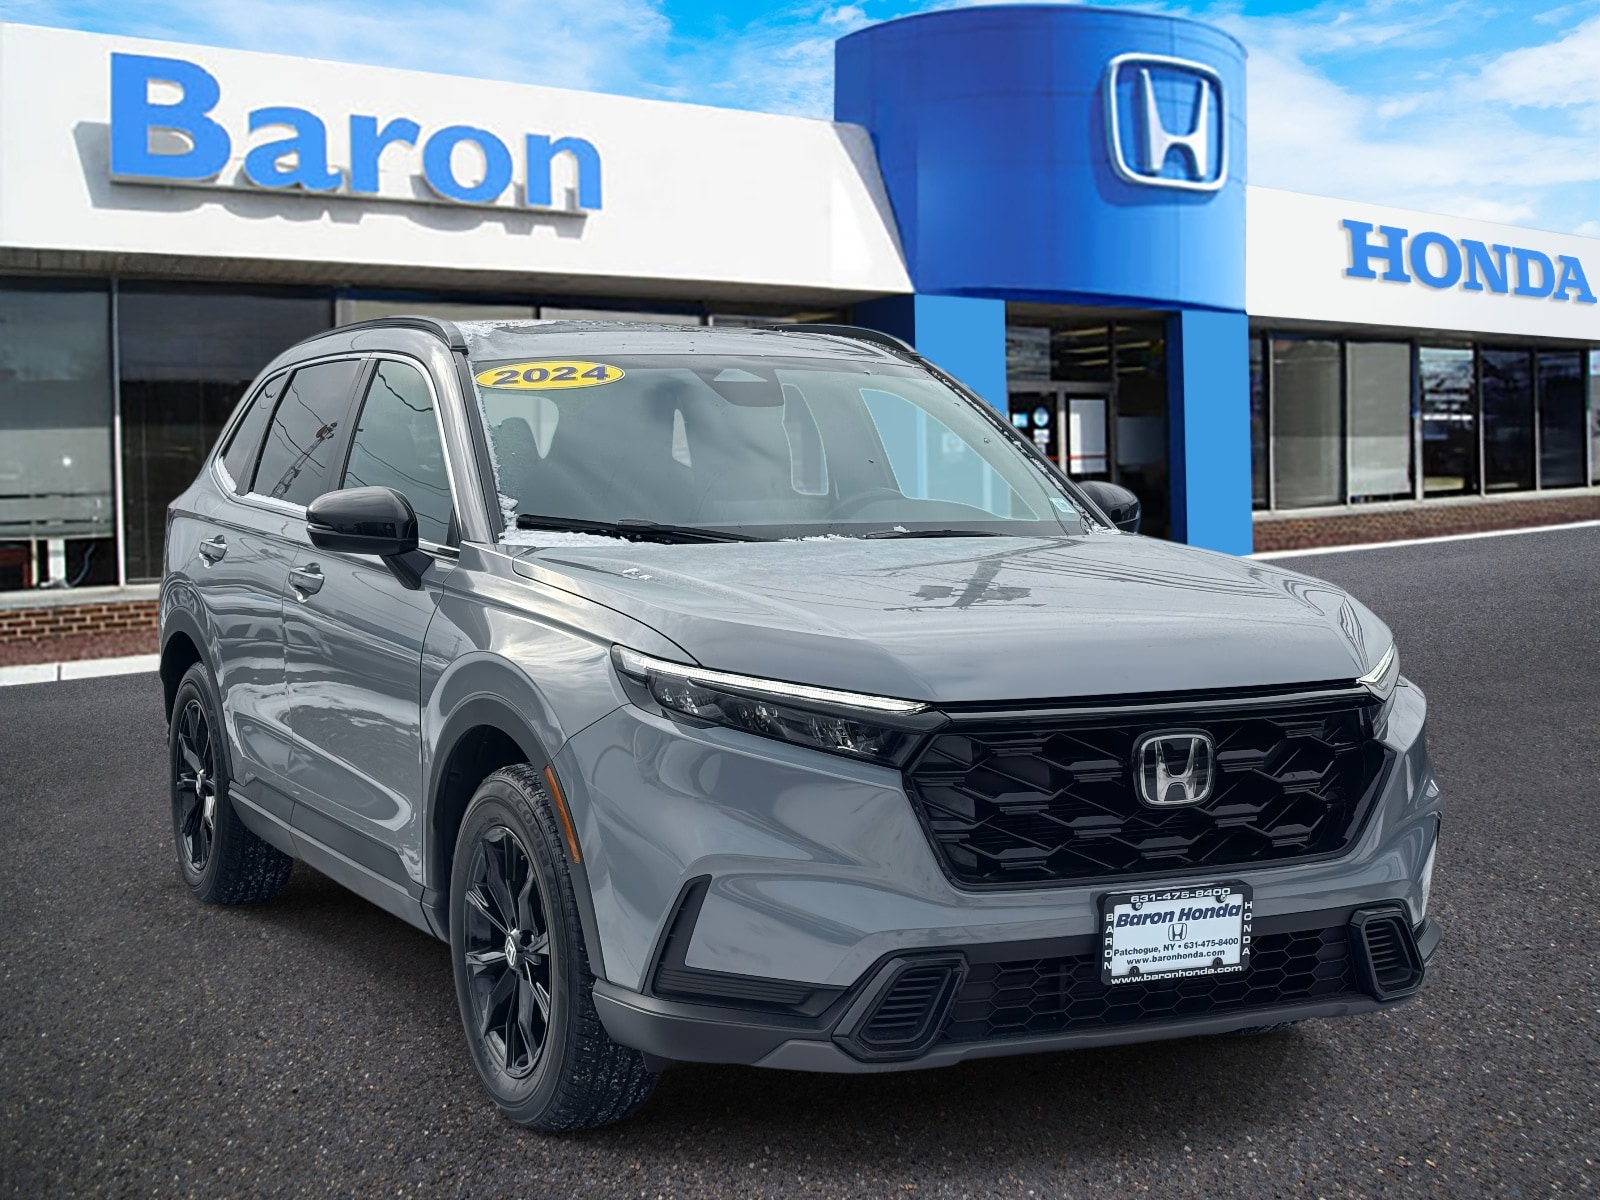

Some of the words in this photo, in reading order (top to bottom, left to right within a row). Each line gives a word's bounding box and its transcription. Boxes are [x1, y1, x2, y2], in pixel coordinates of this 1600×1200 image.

[110, 52, 603, 210] Baron
[1342, 219, 1597, 303] HONDA
[492, 366, 610, 386] 2024
[1130, 888, 1231, 903] 631-475-8400
[1116, 910, 1175, 928] Baron
[1177, 903, 1242, 922] Honda
[1242, 901, 1253, 956] HONDA
[1103, 913, 1114, 970] BARON
[1113, 946, 1161, 957] Patchogue,
[1163, 943, 1176, 953] NY
[1183, 937, 1239, 949] 631-475-8400
[1126, 949, 1226, 966] www.baronhonda.com
[1111, 965, 1242, 985] www.baronhonda.com
